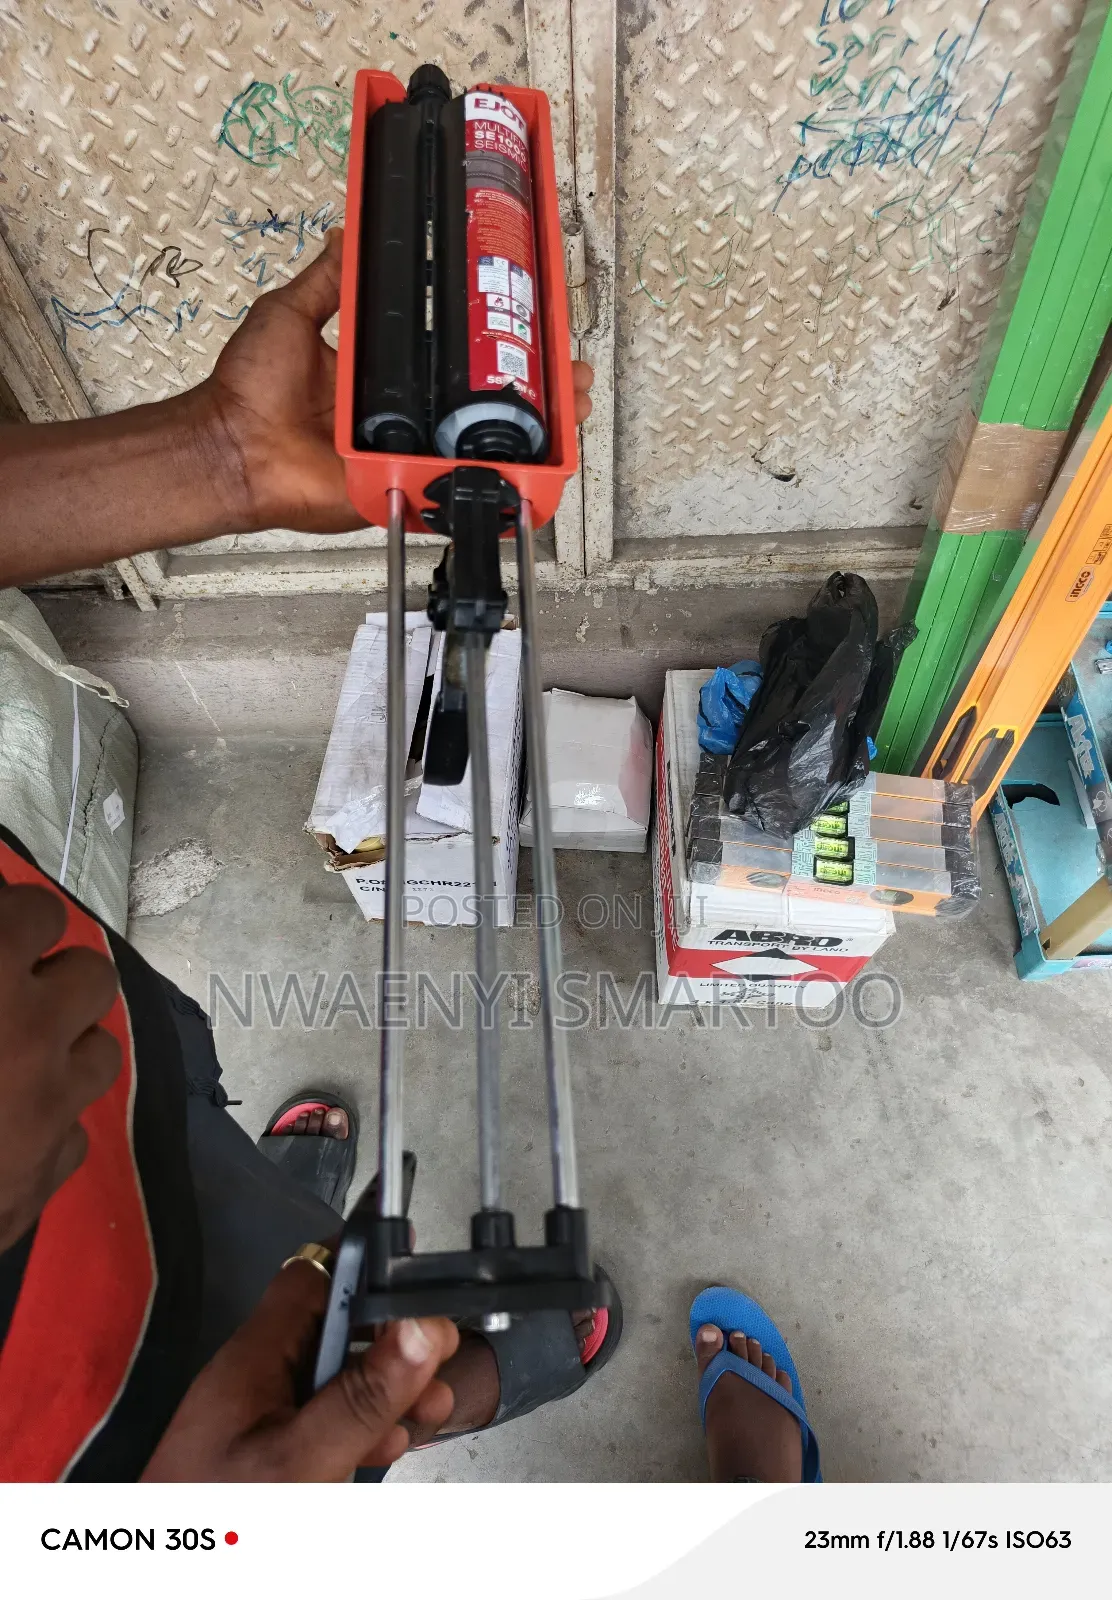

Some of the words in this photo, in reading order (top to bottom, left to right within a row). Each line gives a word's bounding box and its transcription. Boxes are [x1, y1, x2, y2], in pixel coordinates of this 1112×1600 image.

[474, 97, 525, 131] EJOT
[707, 940, 790, 949] TRANSPORT
[712, 929, 843, 948] ABRO
